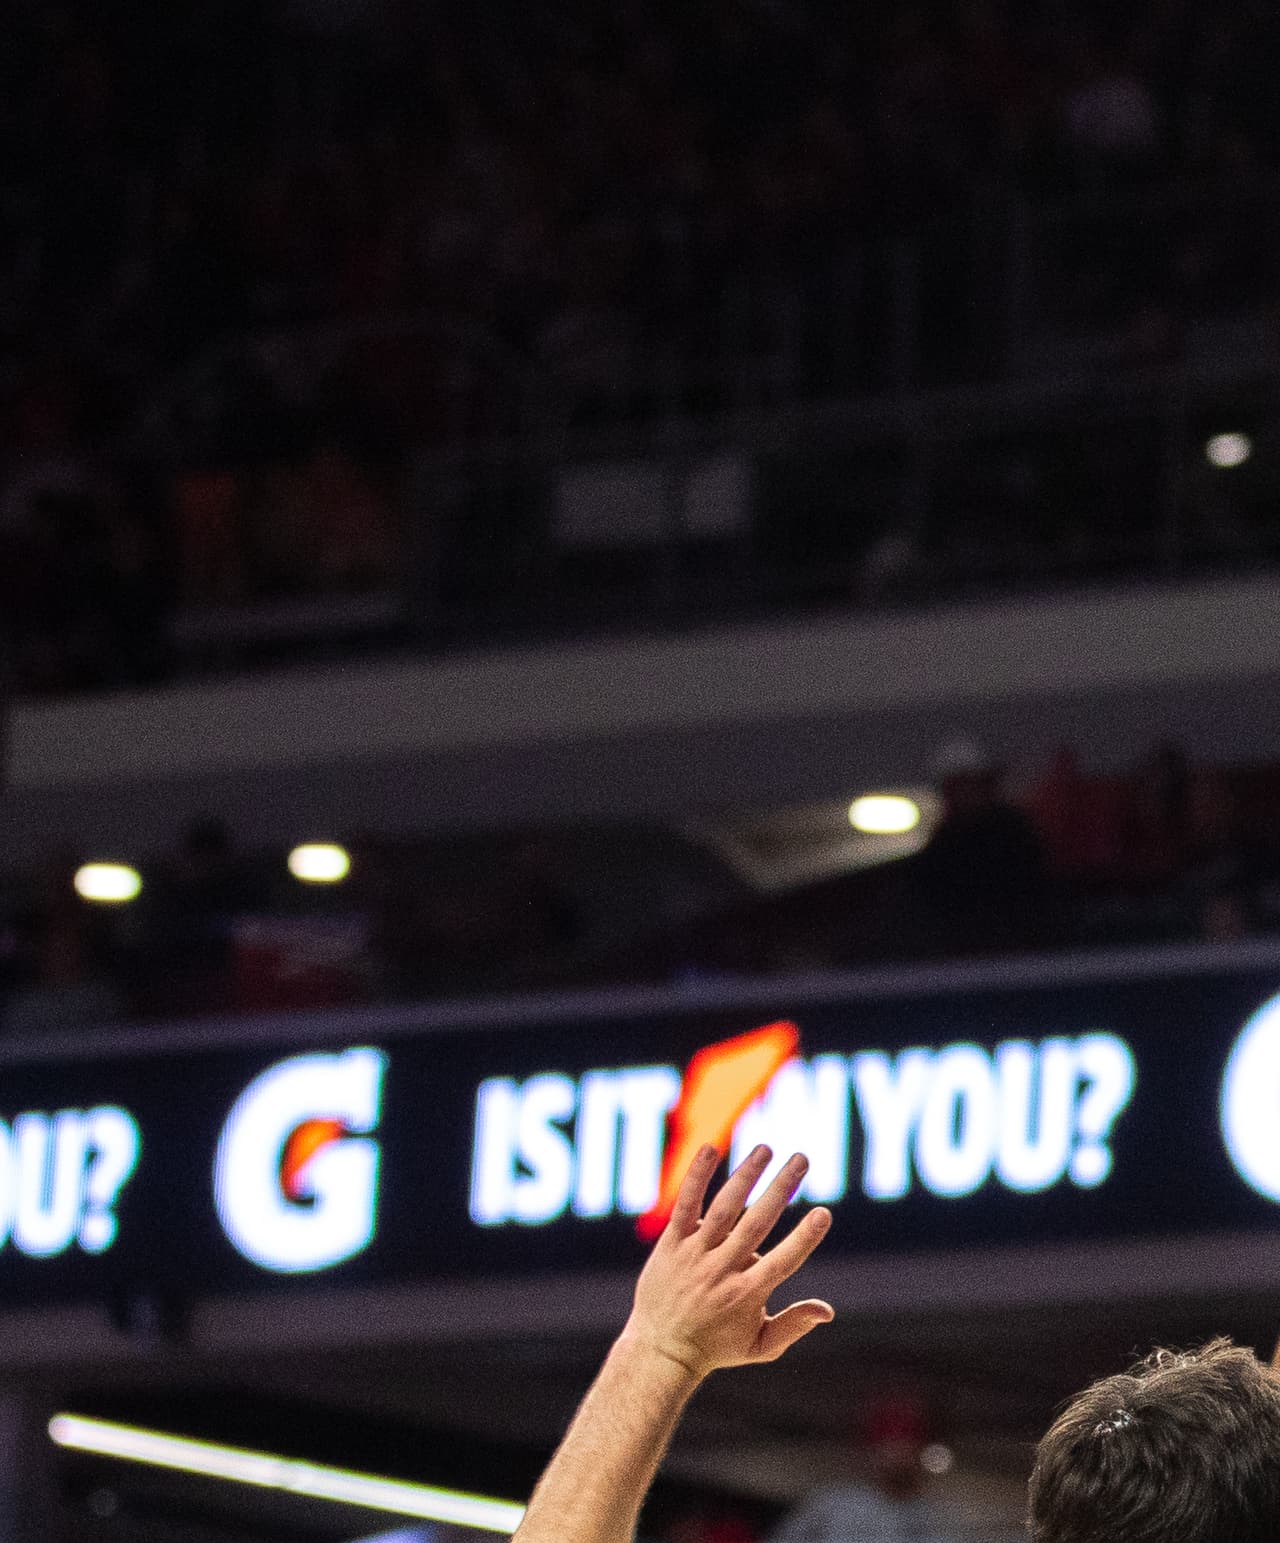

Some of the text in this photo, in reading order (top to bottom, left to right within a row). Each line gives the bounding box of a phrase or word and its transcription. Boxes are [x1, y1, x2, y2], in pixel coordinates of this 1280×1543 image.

[0, 1105, 143, 1259] U?
[213, 1046, 389, 1275] G
[849, 1032, 1136, 1203] YOU?
